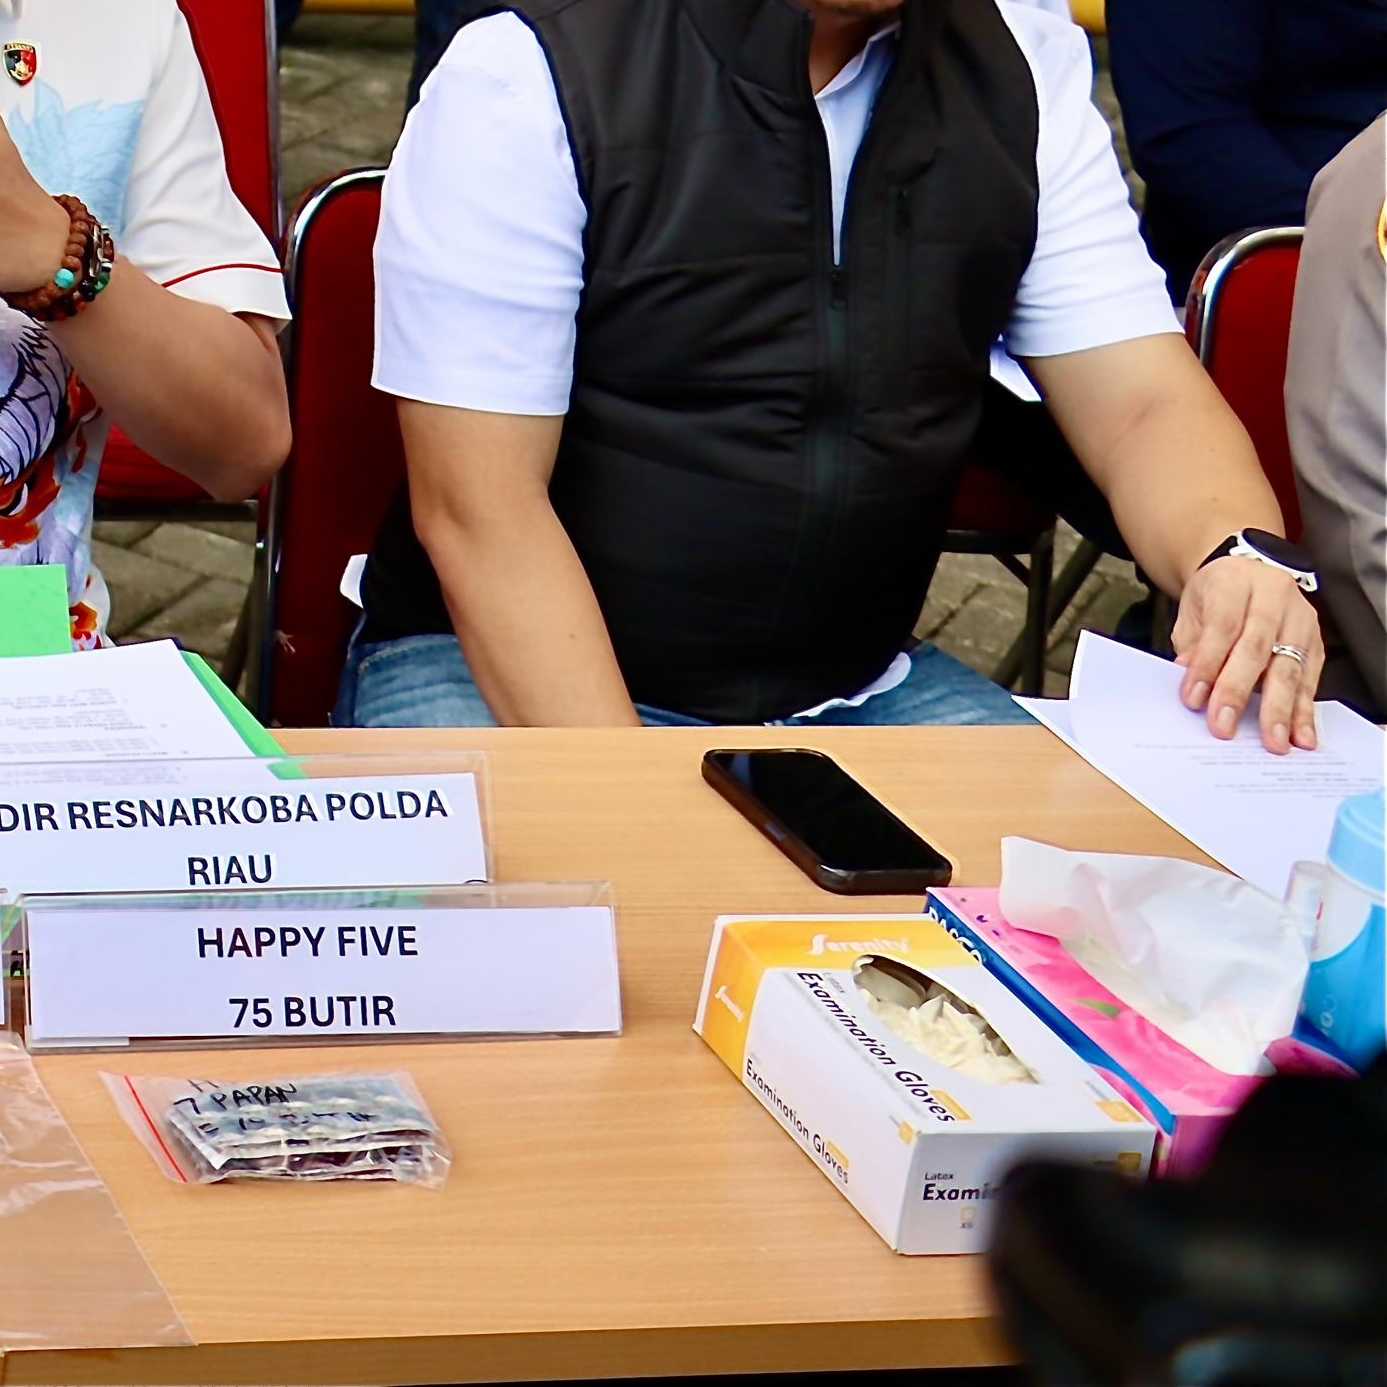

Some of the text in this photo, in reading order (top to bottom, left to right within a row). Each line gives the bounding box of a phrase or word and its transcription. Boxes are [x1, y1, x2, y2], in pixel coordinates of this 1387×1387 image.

[67, 794, 319, 830] RESNARKOBA
[325, 789, 449, 822] POLDA
[188, 854, 272, 886] RIAU
[197, 925, 419, 959] HAPPY FIVE
[805, 933, 910, 956] Serenity
[228, 995, 397, 1029] 75 BUTIR
[797, 971, 898, 1066] Examination
[894, 1070, 956, 1122] Gloves
[210, 1082, 298, 1111] PAPAN
[746, 1057, 849, 1185] Examination Gloves
